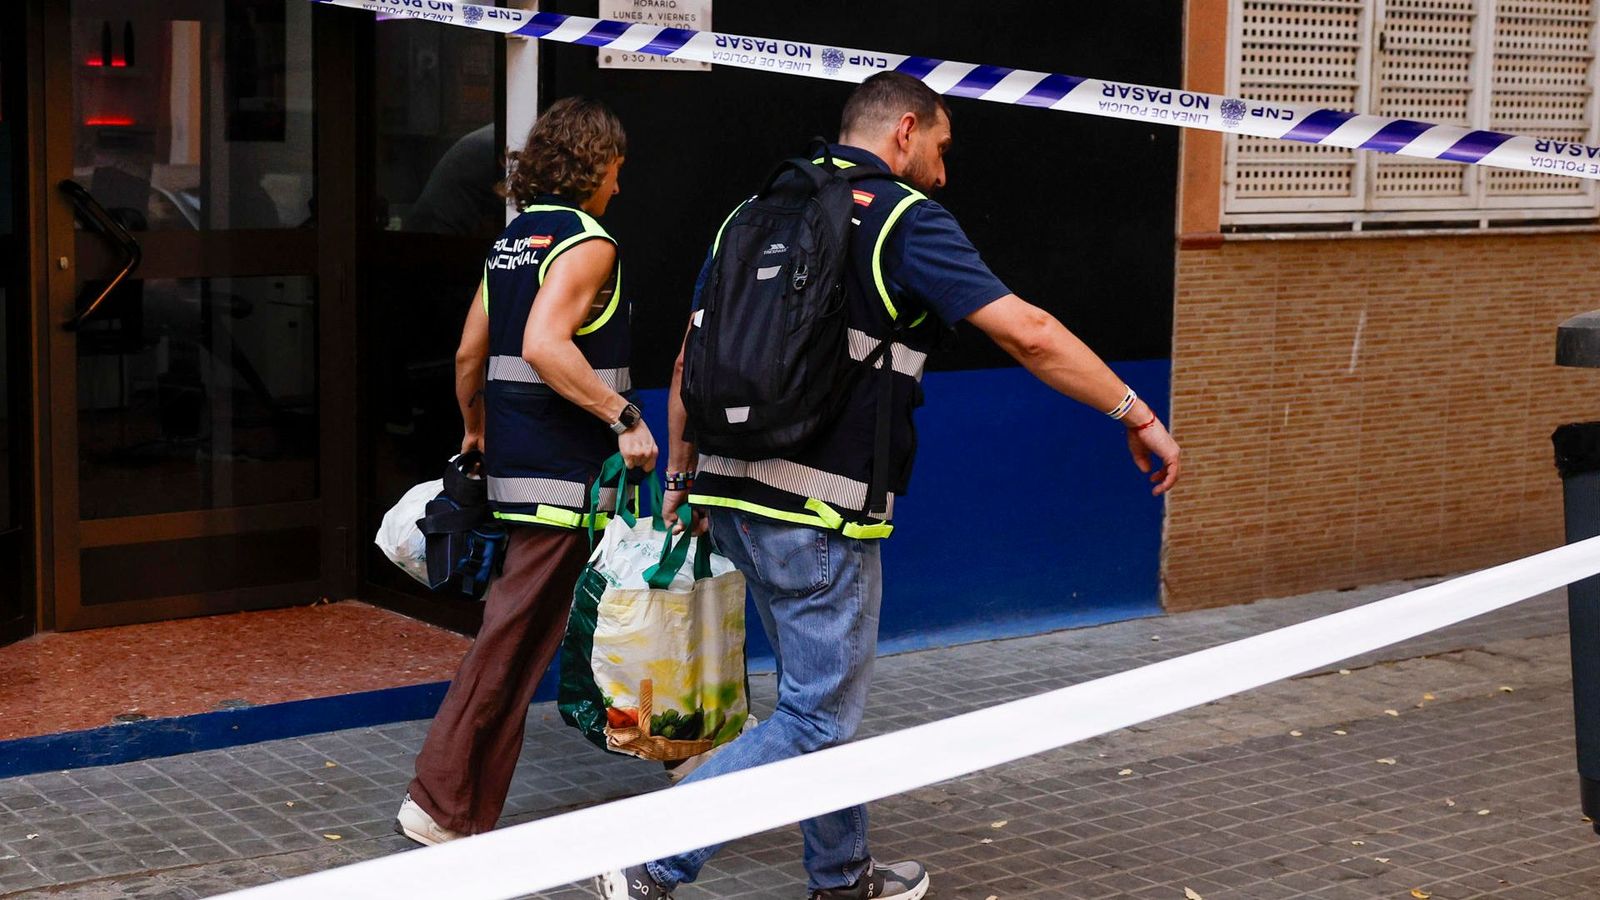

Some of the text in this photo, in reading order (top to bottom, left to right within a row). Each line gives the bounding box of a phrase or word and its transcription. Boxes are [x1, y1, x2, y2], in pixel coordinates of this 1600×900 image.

[428, 0, 454, 12] NO
[633, 0, 677, 8] HORARIO
[407, 9, 420, 17] DE
[423, 12, 454, 22] LINEA
[487, 11, 523, 22] CNP
[613, 11, 642, 20] LUNES
[658, 12, 697, 22] VIERNES
[714, 34, 812, 59] NO PASAR
[712, 50, 812, 72] LINEA DE POLICIA
[849, 55, 888, 69] CNP
[1102, 83, 1210, 110] NO PASAR
[1099, 100, 1209, 125] LINEA DE POLICIA
[1251, 106, 1295, 121] CNP
[1534, 139, 1600, 159] ASAR
[1530, 156, 1586, 173] POLICIA
